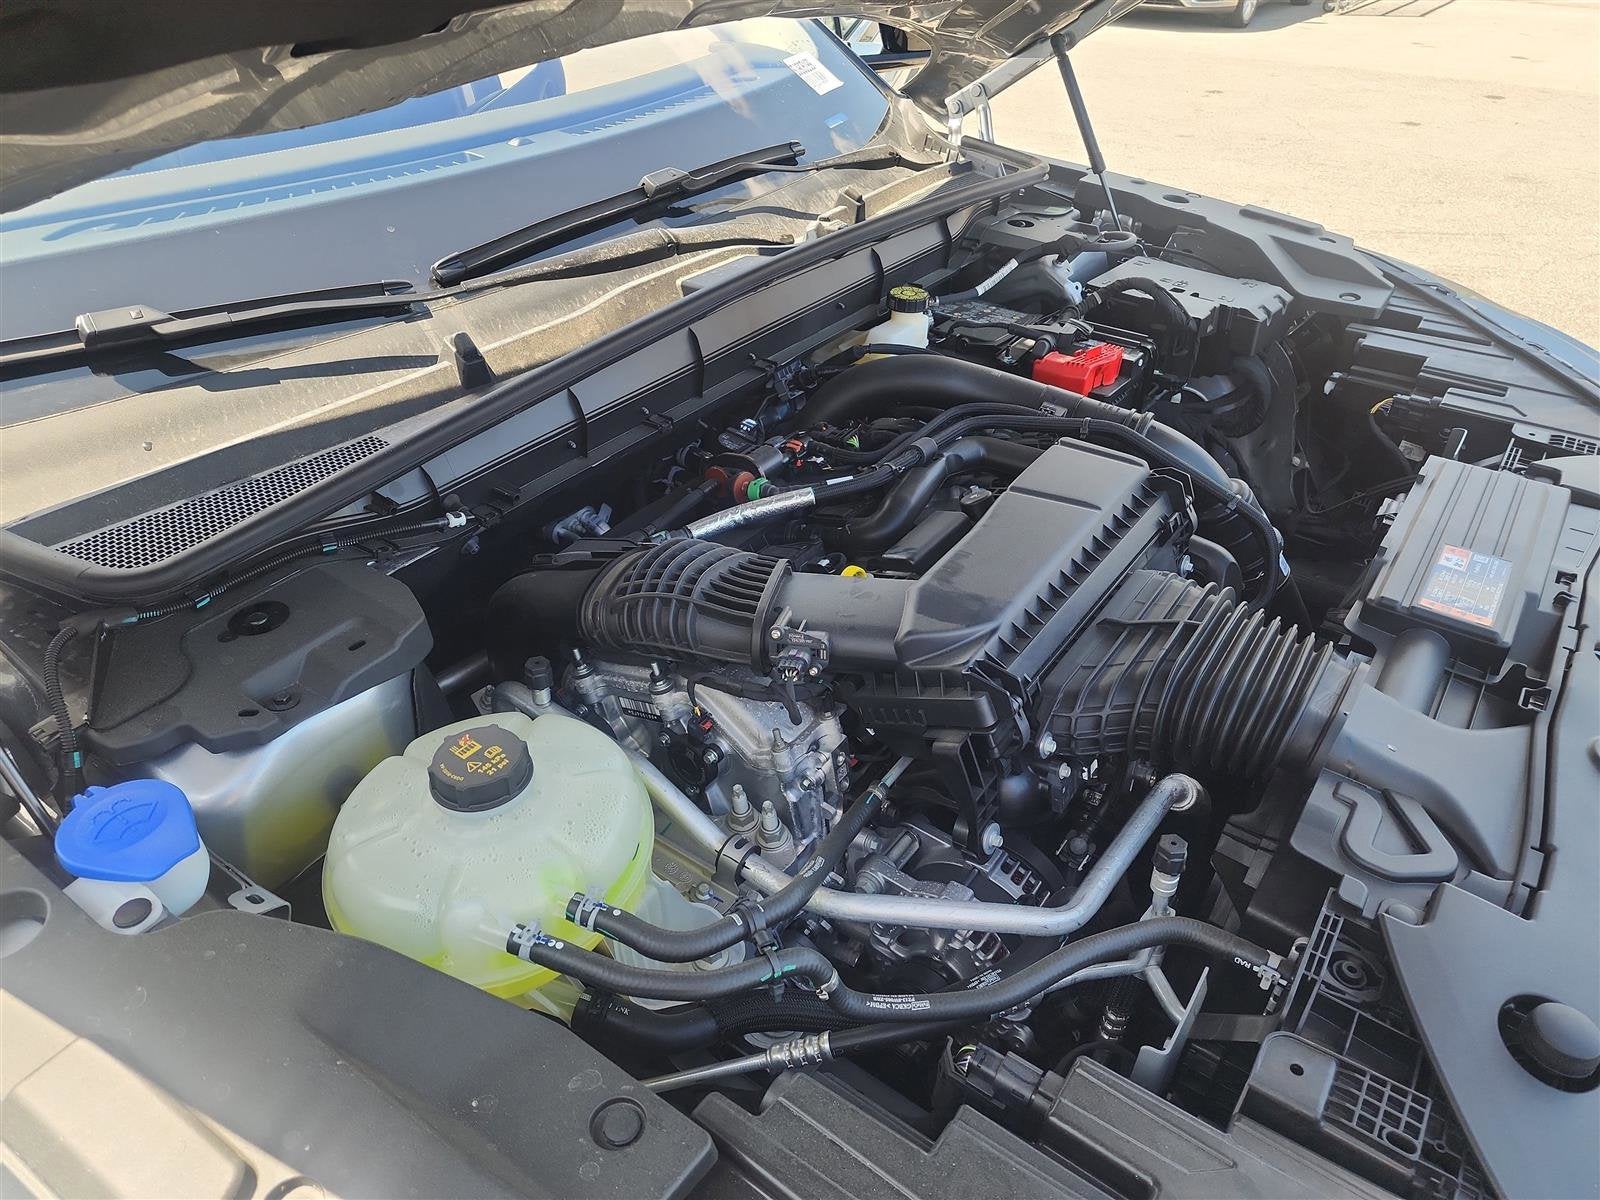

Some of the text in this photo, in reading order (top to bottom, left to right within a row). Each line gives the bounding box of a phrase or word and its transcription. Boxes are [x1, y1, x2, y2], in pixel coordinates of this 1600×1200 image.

[477, 762, 492, 774] 145
[486, 767, 497, 776] 21
[1234, 957, 1251, 969] RAD
